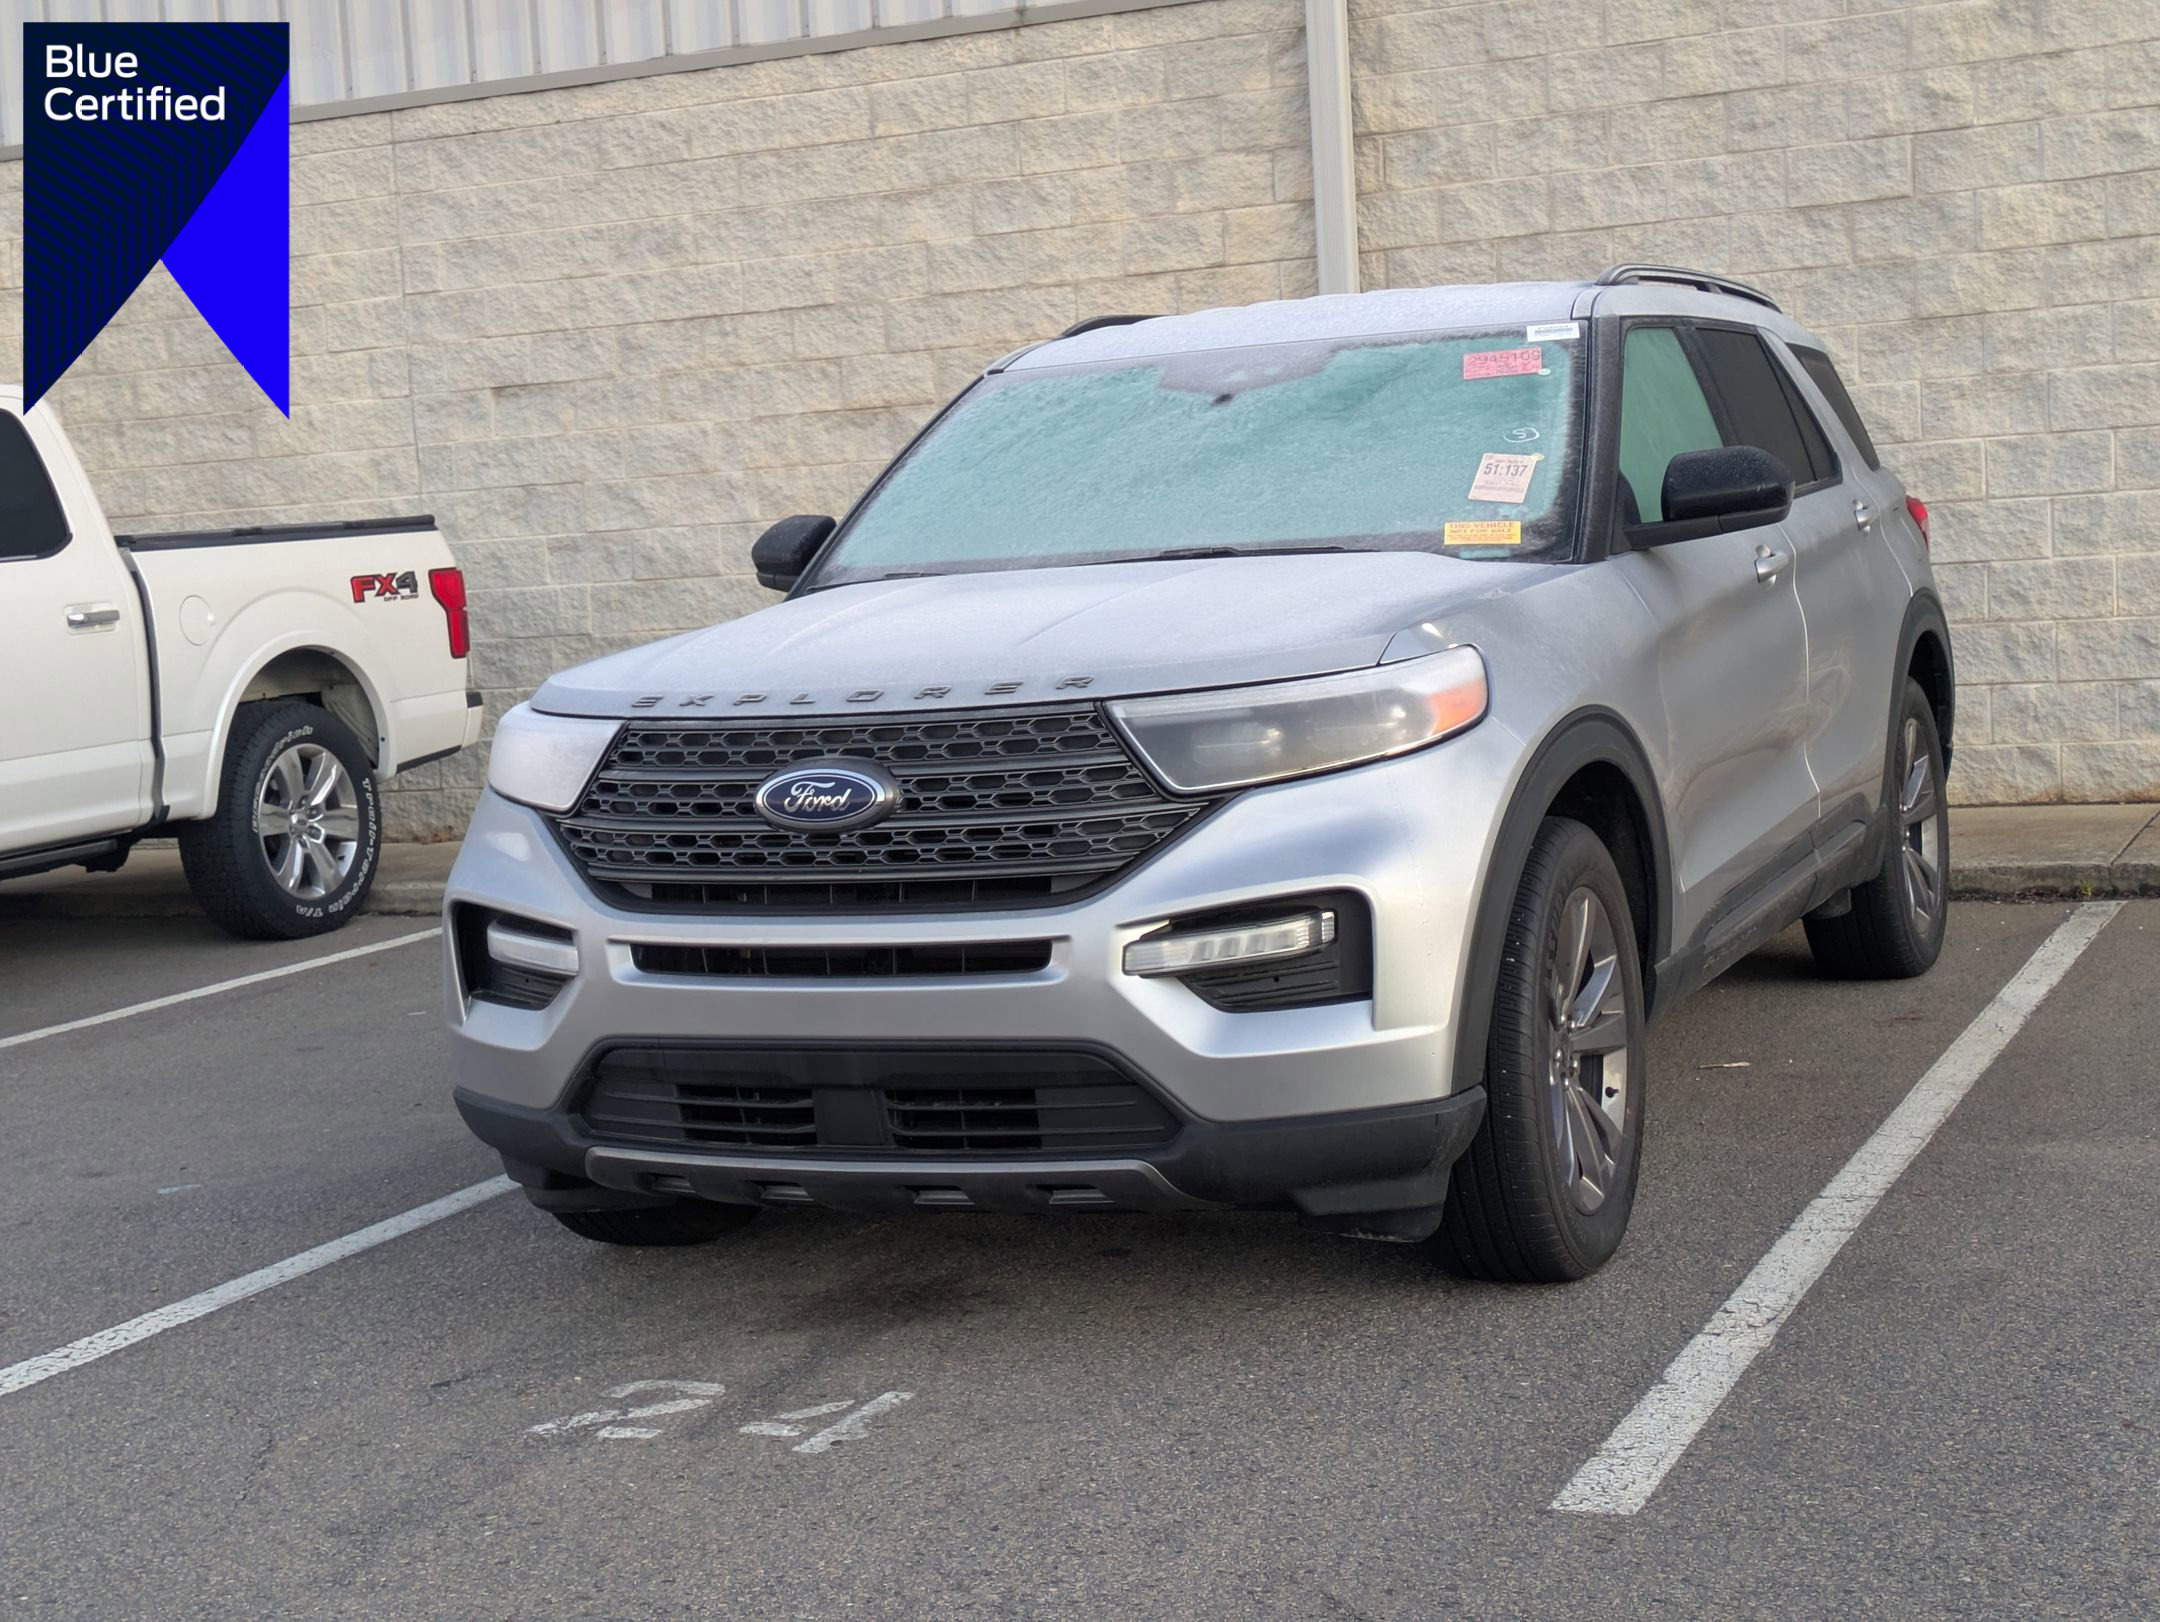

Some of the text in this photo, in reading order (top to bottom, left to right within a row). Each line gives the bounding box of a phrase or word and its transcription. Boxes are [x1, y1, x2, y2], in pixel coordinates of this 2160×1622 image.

[1483, 463, 1528, 477] 51:137
[350, 570, 418, 604] FX4
[630, 674, 1097, 708] EXPLORER
[783, 781, 853, 812] Ford
